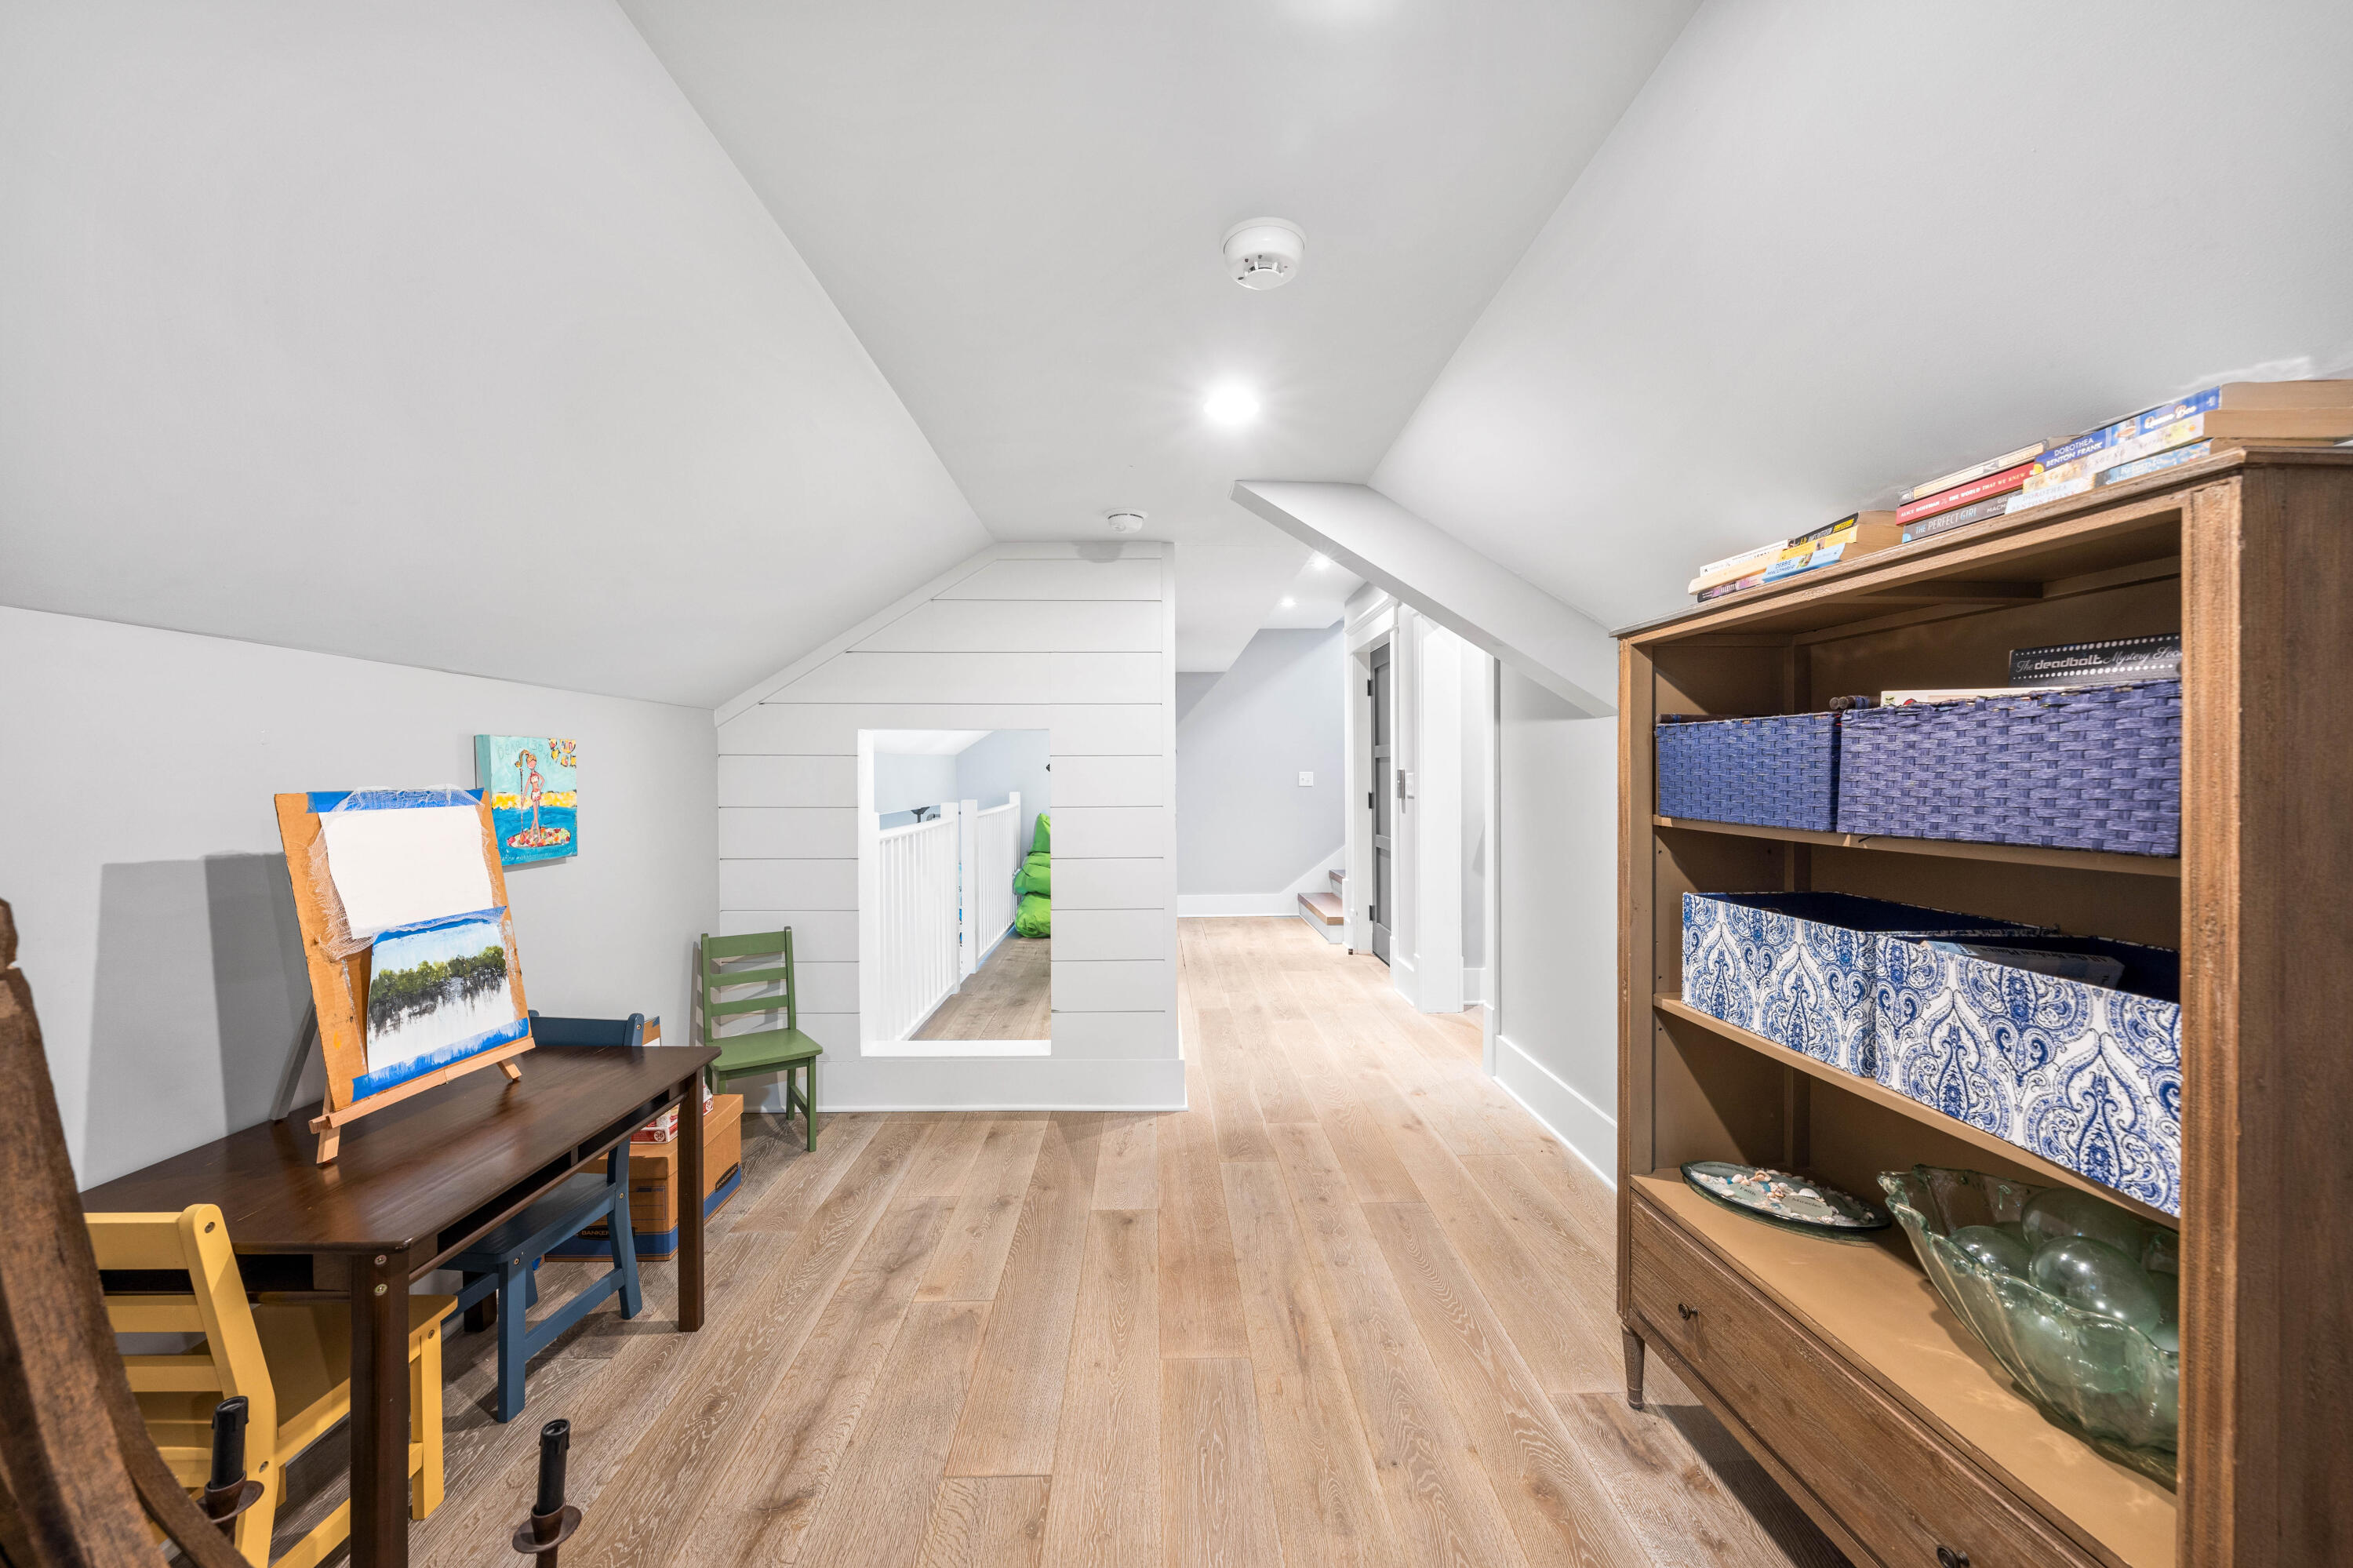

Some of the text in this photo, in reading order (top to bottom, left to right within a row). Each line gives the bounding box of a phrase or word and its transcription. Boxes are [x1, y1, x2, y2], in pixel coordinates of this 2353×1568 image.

[2046, 453, 2075, 467] BENTON
[2077, 442, 2104, 457] FRANK
[2054, 438, 2094, 457] DOROTHEA
[1900, 509, 1915, 518] ALICE
[1915, 500, 1940, 513] HOFFMAN
[1961, 487, 1980, 499] WORLD
[1982, 482, 1997, 492] THAT
[1998, 477, 2007, 486] WE
[2008, 472, 2026, 482] KNEW
[1915, 507, 1977, 534] THE PERFECT GIRL
[2016, 660, 2034, 672] The
[2034, 654, 2103, 671] deadbolt
[2103, 650, 2151, 665] Mystery
[1739, 1186, 1756, 1196] Faith
[1791, 1197, 1822, 1209] Miracles
